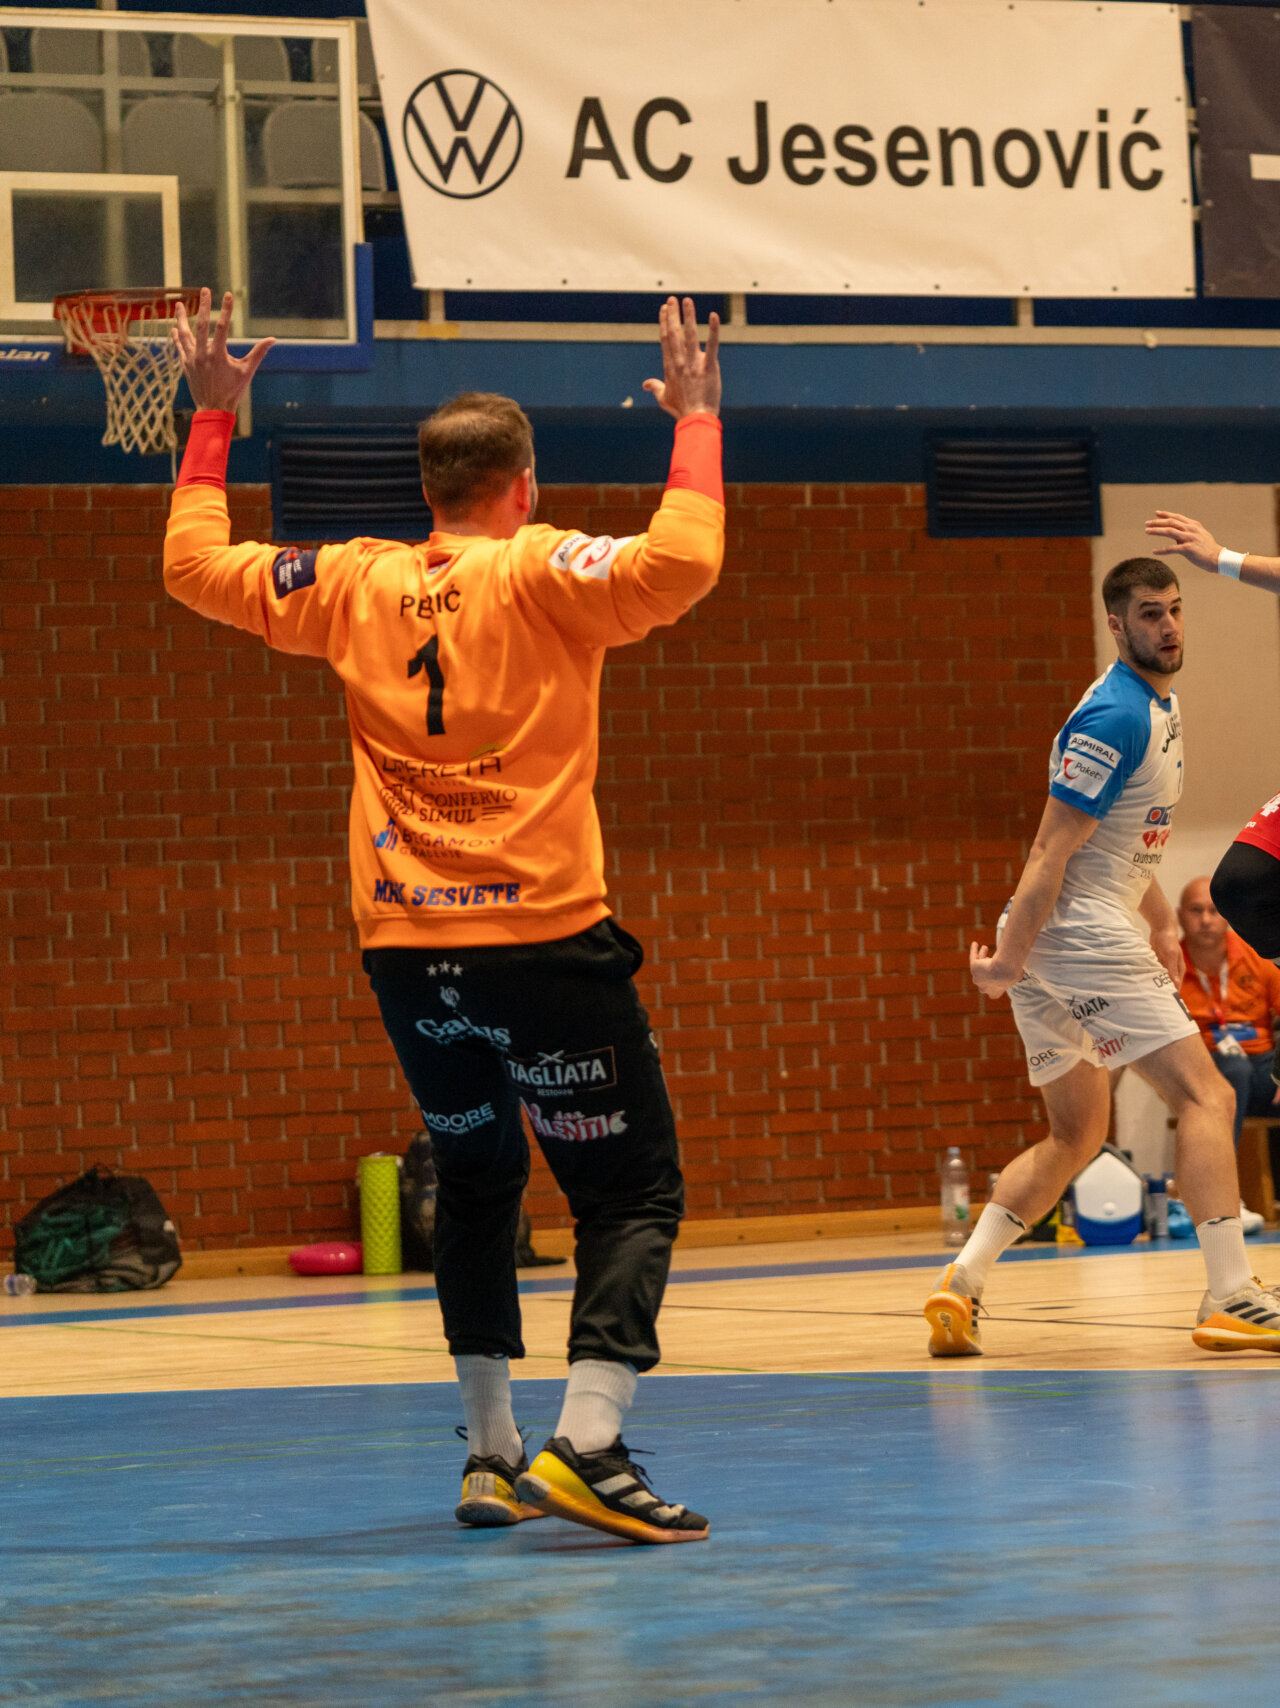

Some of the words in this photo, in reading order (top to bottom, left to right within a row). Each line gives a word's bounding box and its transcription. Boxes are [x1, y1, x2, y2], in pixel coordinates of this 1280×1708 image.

[565, 96, 695, 184] AC
[726, 100, 1165, 192] Jesenović
[407, 633, 446, 736] 1
[1070, 737, 1115, 763] ADMIRAL
[419, 806, 477, 824] SIMUL
[411, 882, 520, 906] SESVETE
[507, 1059, 607, 1086] TAGLIATA
